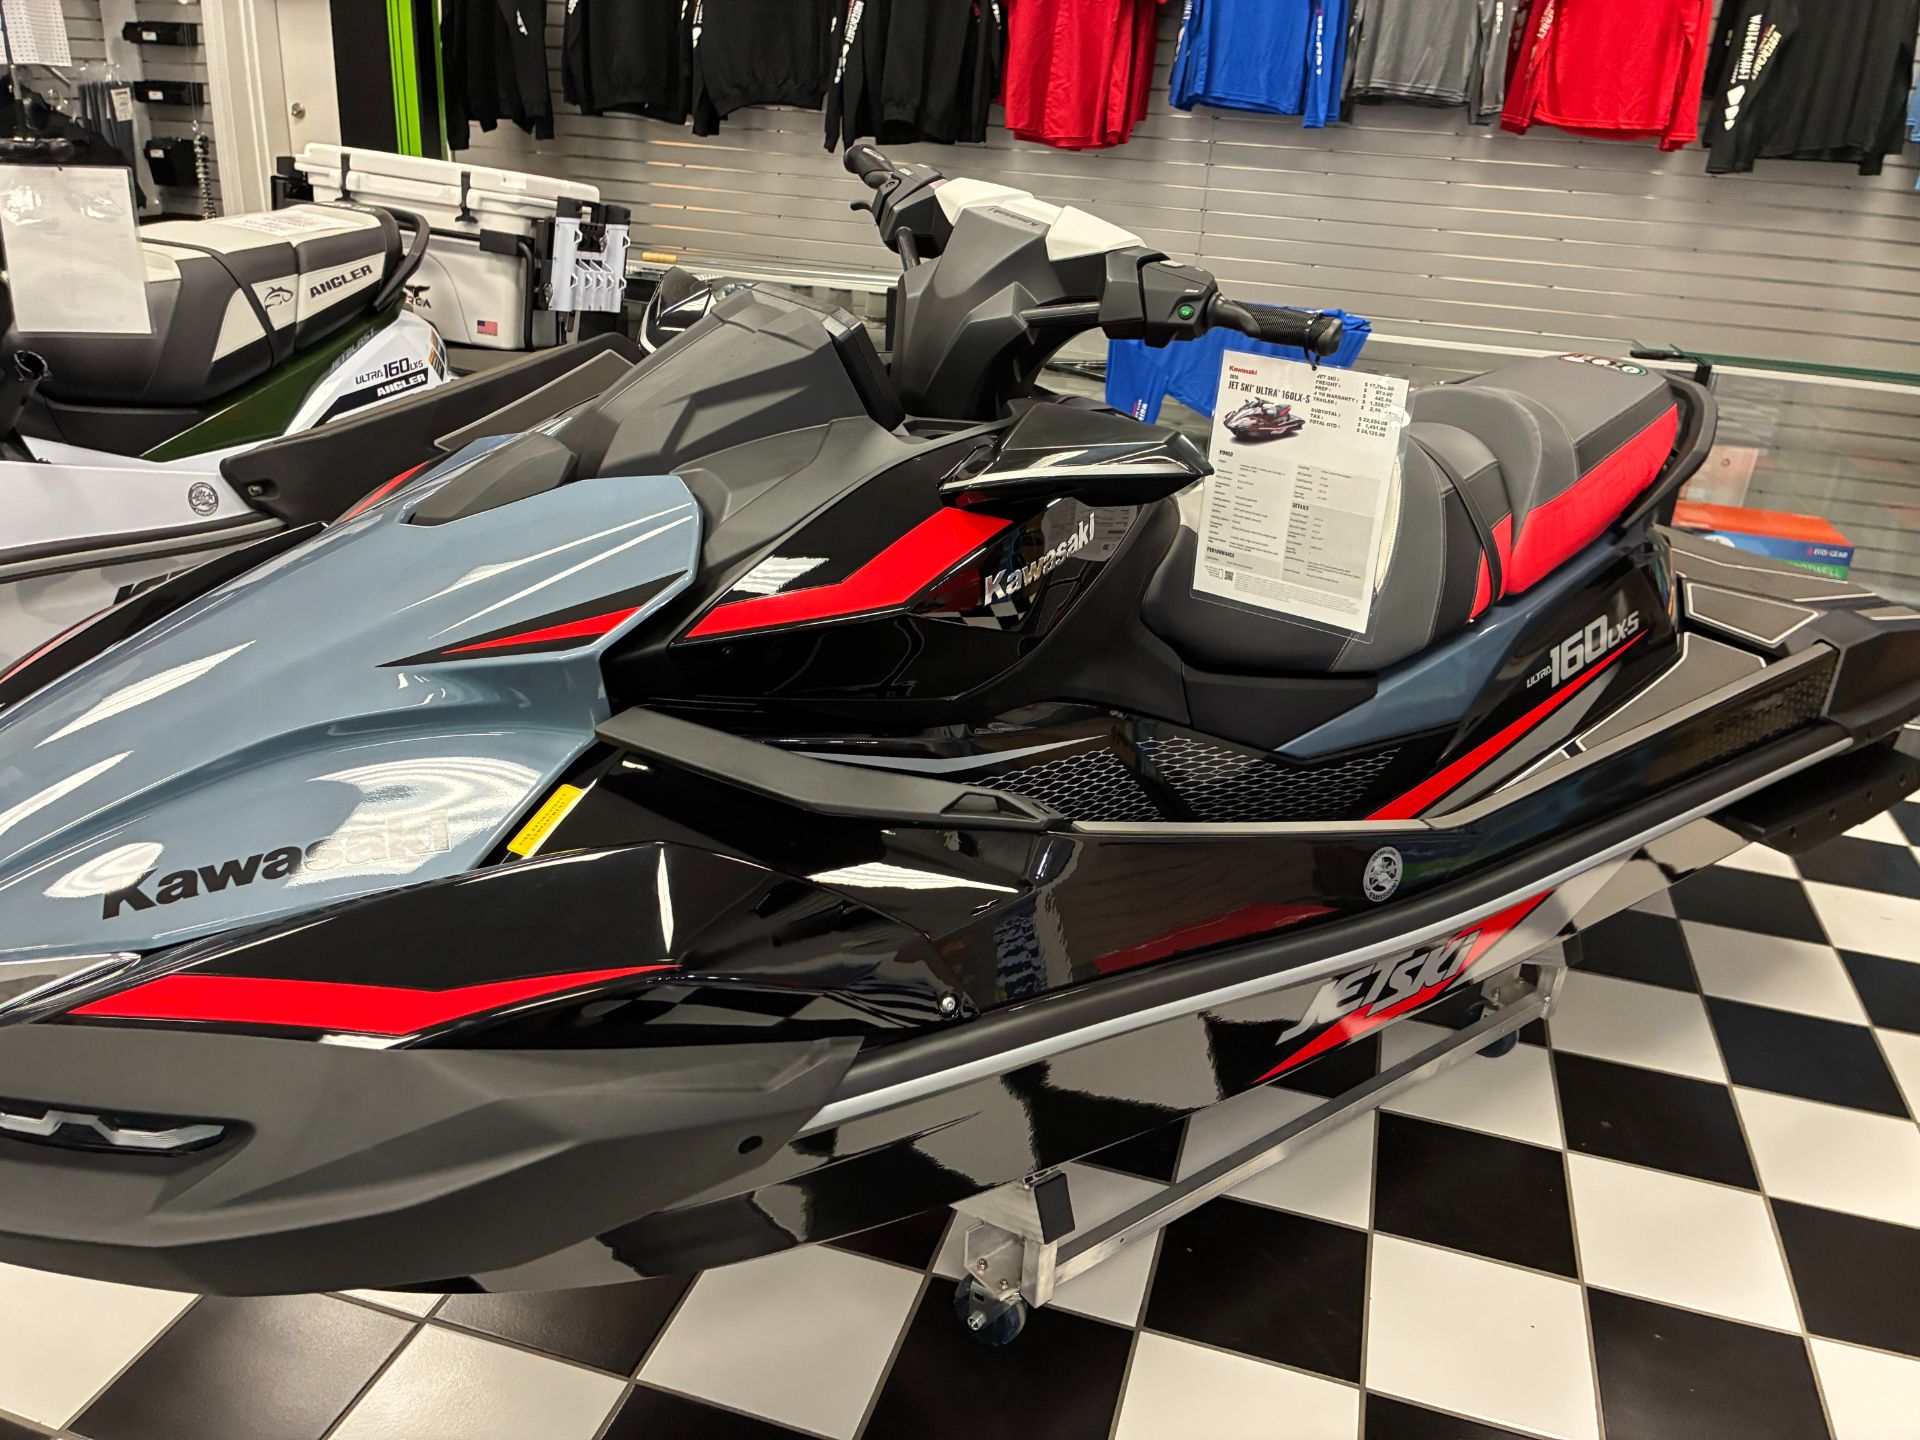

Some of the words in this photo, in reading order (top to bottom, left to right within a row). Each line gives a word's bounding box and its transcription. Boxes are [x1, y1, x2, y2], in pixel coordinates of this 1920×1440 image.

[309, 264, 373, 298] ANGLER
[355, 369, 384, 385] ULTRA
[1229, 365, 1257, 375] Kawasaki
[377, 372, 426, 397] ANGLER
[1228, 381, 1239, 390] JET
[1282, 390, 1310, 403] 160LX-S
[1315, 379, 1338, 387] FREIGHT
[1313, 396, 1334, 404] TRAILER
[1326, 393, 1355, 402] WARRANTY
[1311, 407, 1337, 416] SUBTOTAL
[1309, 419, 1325, 427] TOTAL
[983, 512, 1095, 607] Kawasaki
[1526, 666, 1552, 688] ULTRA
[530, 802, 565, 841] COMPARTMENT
[102, 809, 451, 920] Kawasaki
